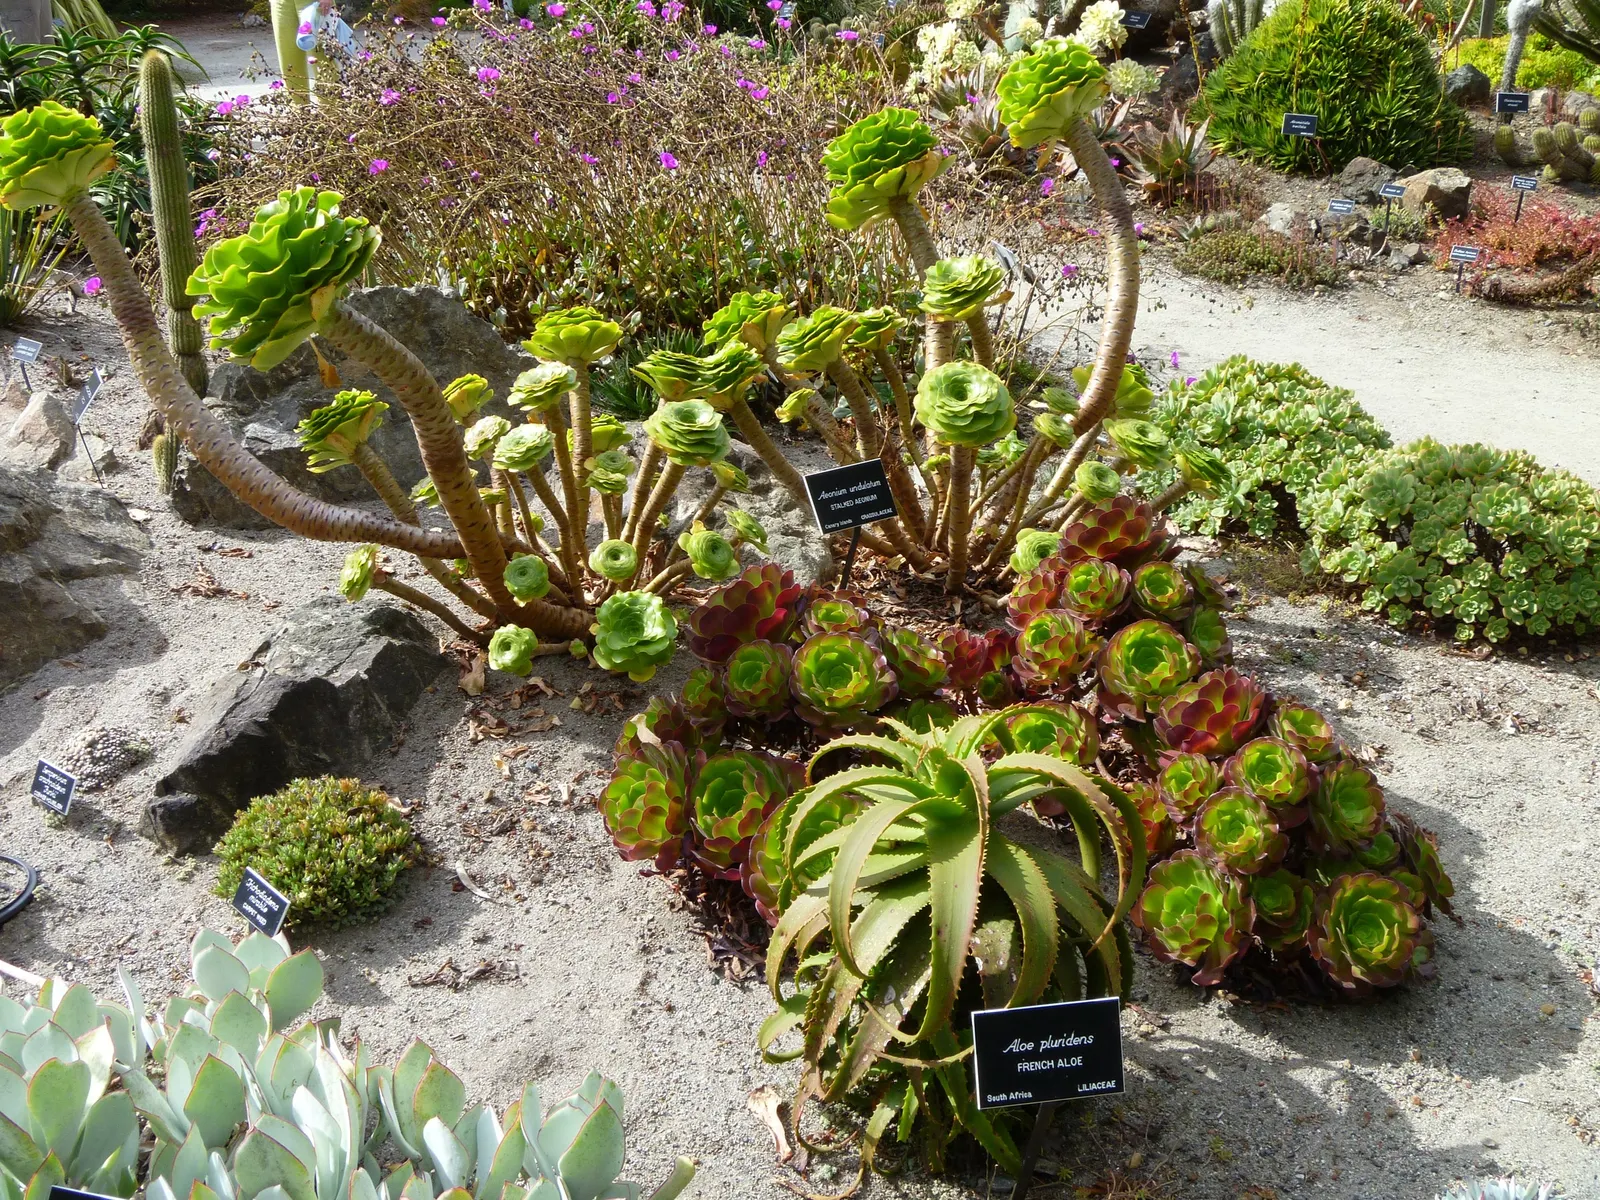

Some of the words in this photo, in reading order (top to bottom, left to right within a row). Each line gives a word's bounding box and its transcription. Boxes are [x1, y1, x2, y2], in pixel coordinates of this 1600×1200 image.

[818, 488, 847, 500] Aeonium
[849, 480, 881, 493] undulatum
[830, 500, 854, 510] STALKED
[855, 494, 877, 505] AEONIUM
[1003, 1038, 1034, 1053] Aloe
[1040, 1030, 1094, 1052] pluridens
[1017, 1059, 1054, 1072] FRENCH
[1057, 1056, 1083, 1068] ALOE
[1077, 1080, 1116, 1092] LILIACEAE
[987, 1094, 1007, 1102] South
[1009, 1091, 1032, 1100] Africa
